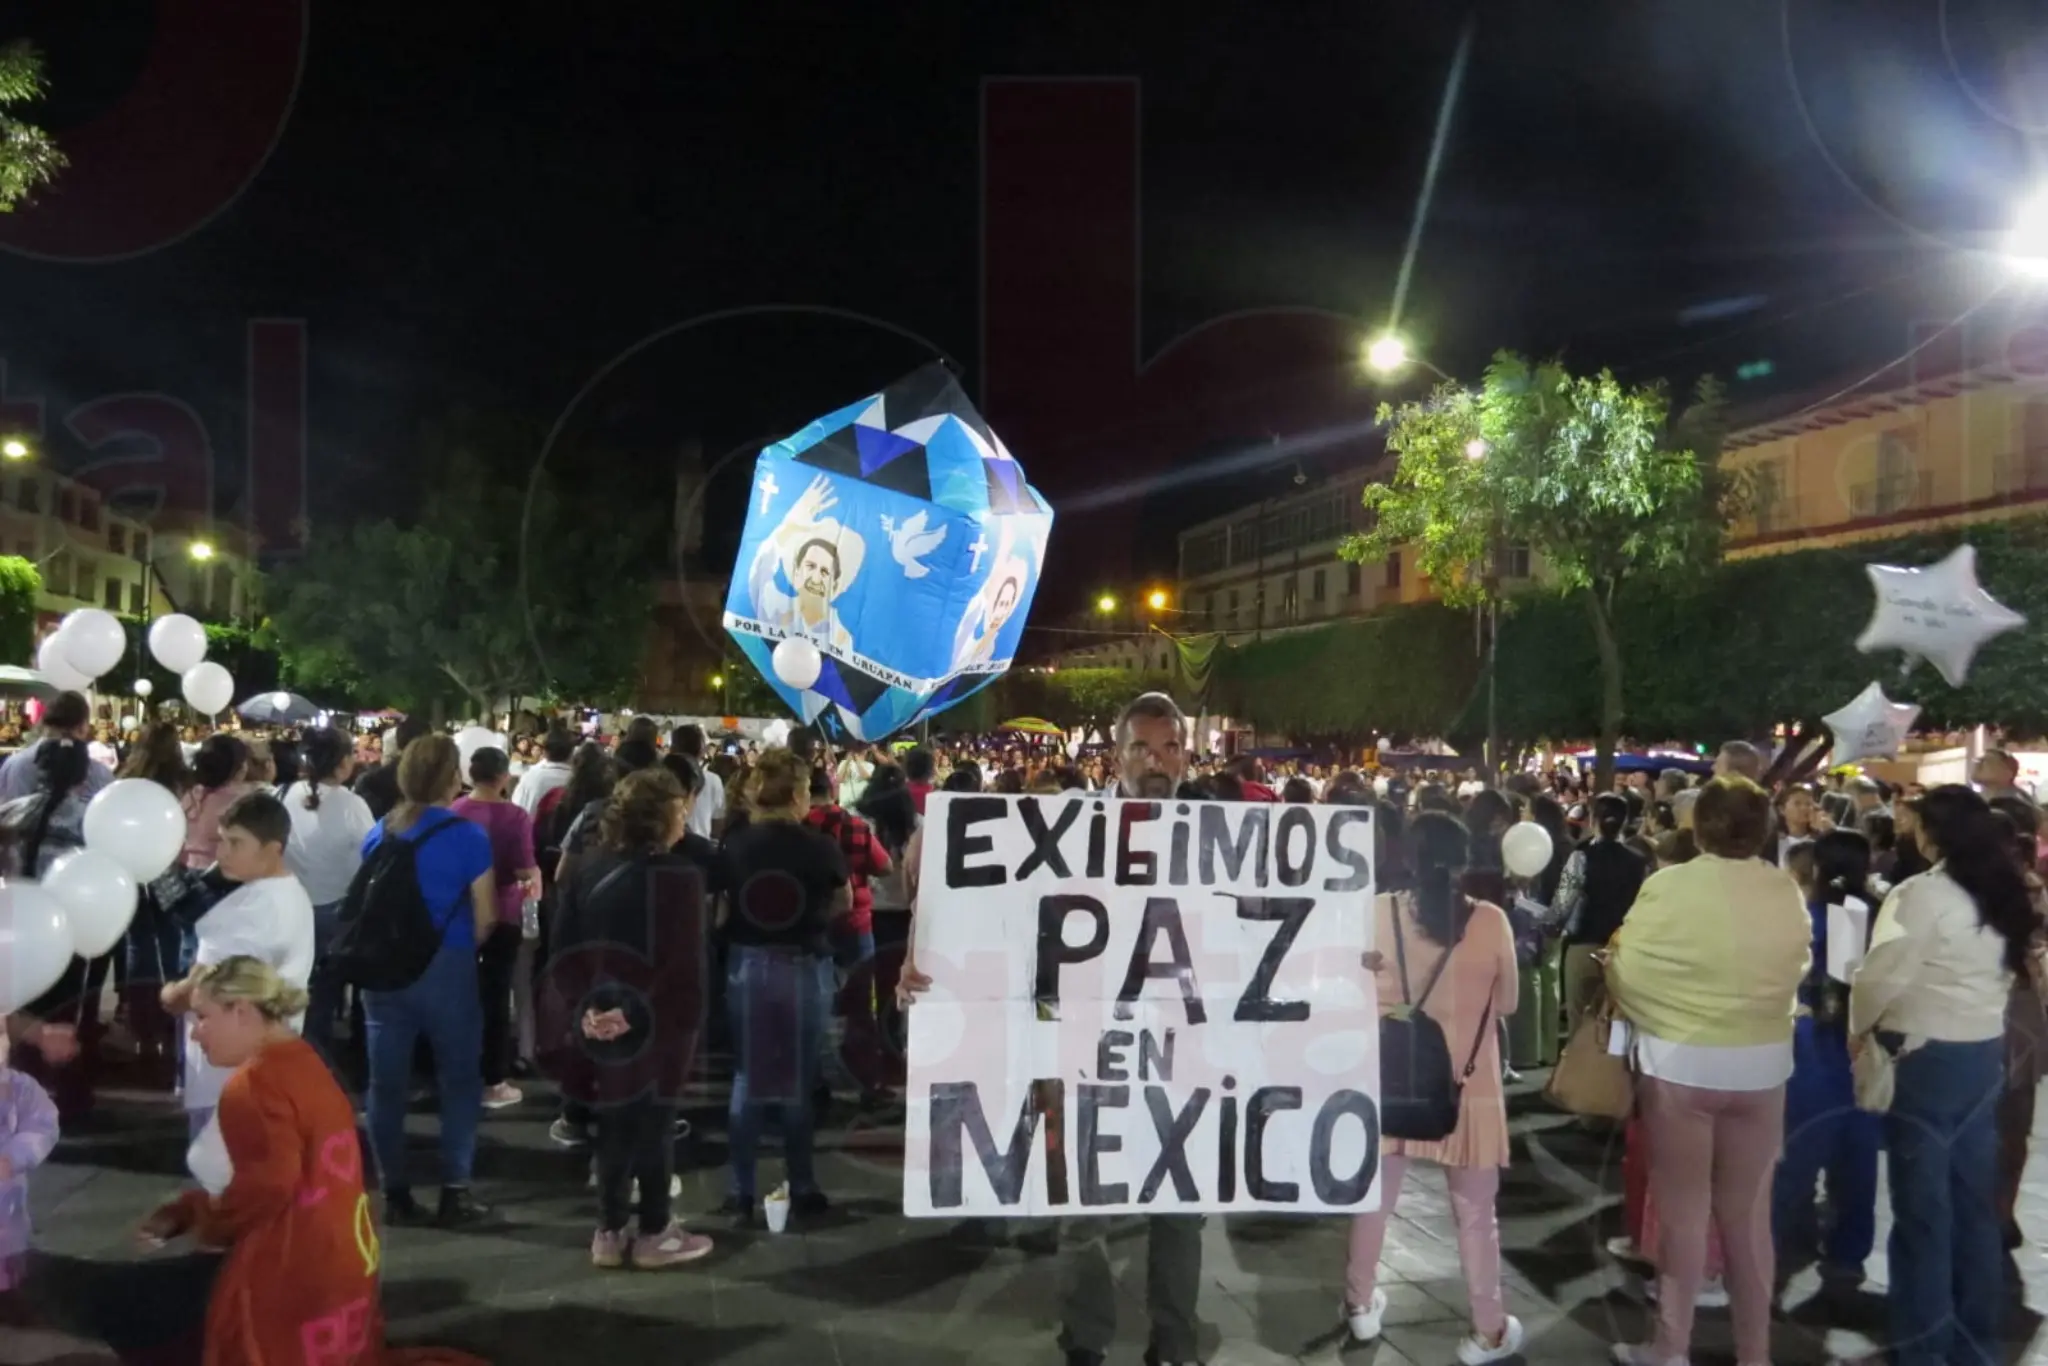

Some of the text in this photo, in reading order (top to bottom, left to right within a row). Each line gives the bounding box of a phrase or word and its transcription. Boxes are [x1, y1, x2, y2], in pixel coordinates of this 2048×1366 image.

[734, 618, 762, 633] POR
[768, 626, 787, 639] LA
[851, 654, 913, 690] URUAPAN
[1033, 891, 1316, 1024] PAZ
[1097, 1027, 1176, 1082] EN
